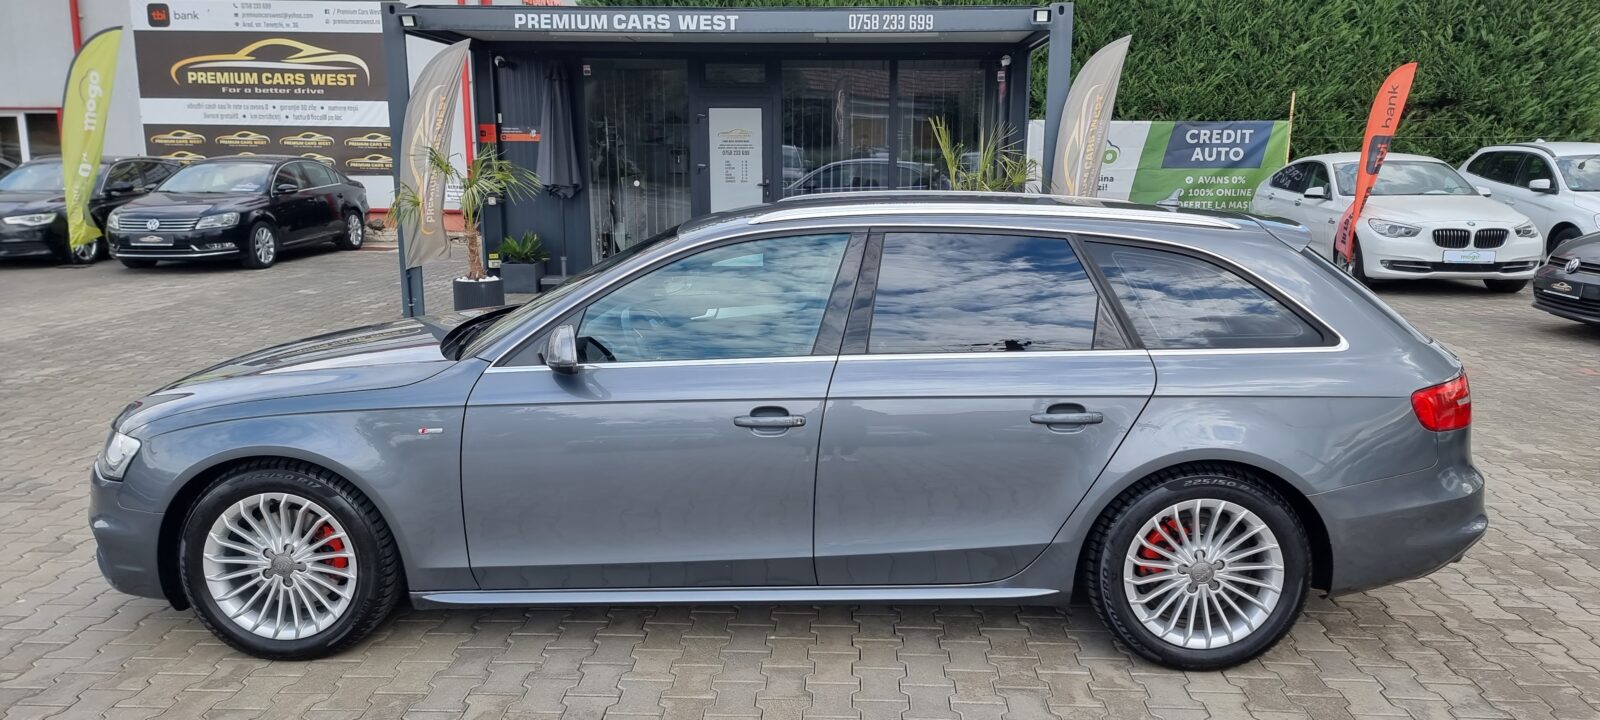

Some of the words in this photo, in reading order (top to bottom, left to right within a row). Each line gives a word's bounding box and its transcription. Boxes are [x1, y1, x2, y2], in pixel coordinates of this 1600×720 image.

[151, 10, 166, 21] tbi
[174, 10, 199, 21] bank
[514, 13, 608, 30] PREMIUM
[612, 14, 671, 30] CARS
[678, 15, 739, 31] WEST
[849, 14, 879, 30] 0758
[882, 14, 905, 30] 233
[909, 15, 934, 30] 699
[187, 72, 258, 84] PREMIUM
[262, 72, 305, 85] CARS
[311, 73, 357, 86] WEST
[84, 70, 102, 132] mogo
[1381, 84, 1399, 128] bank
[1185, 129, 1254, 144] CREDIT
[1191, 147, 1244, 162] AUTO
[1197, 175, 1230, 184] AVANS
[1231, 175, 1246, 184] 0%
[1188, 188, 1214, 197] 100%
[1216, 188, 1252, 197] ONLINE
[1215, 201, 1225, 209] LA
[1184, 478, 1237, 487] 225/50
